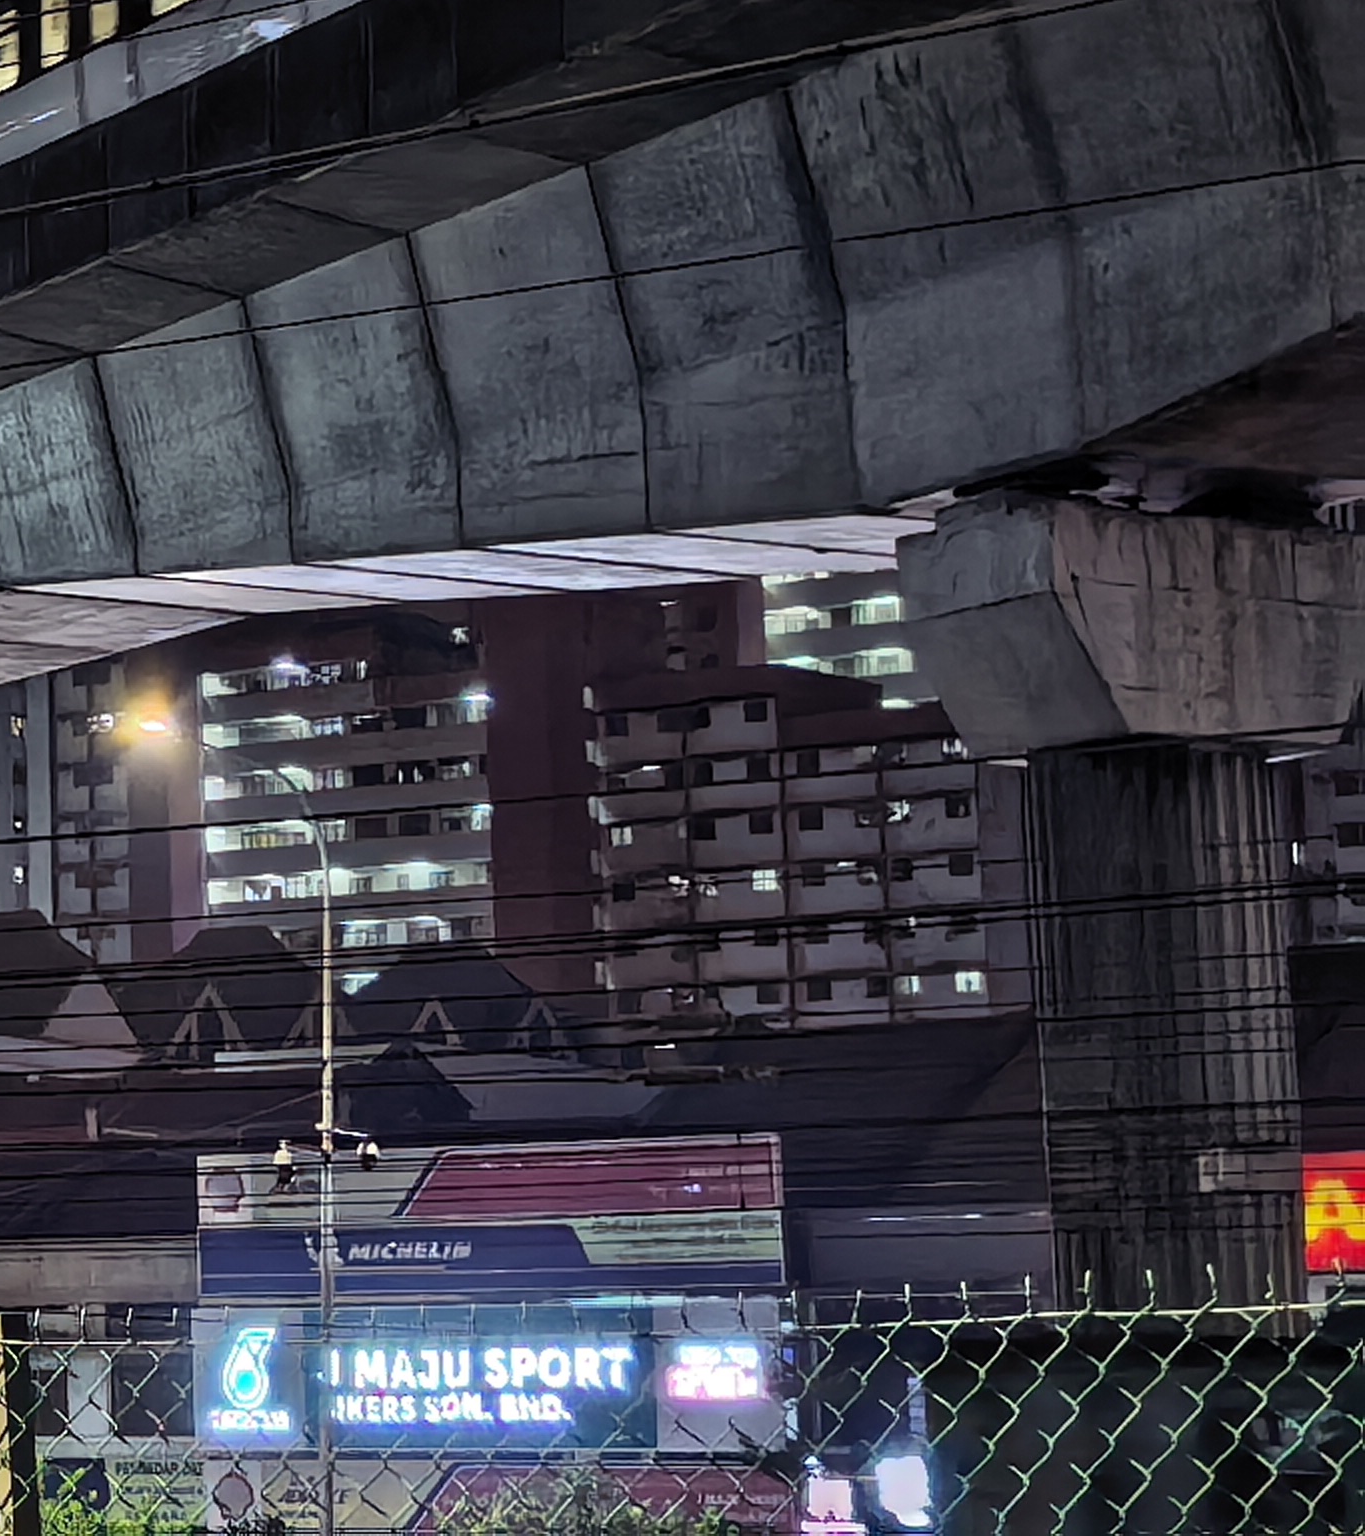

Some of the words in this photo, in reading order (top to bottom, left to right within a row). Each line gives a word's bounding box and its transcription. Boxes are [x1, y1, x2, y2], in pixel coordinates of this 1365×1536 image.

[348, 1241, 472, 1261] MICHELIN
[354, 1349, 470, 1390] MAJU
[483, 1347, 633, 1390] SPORT
